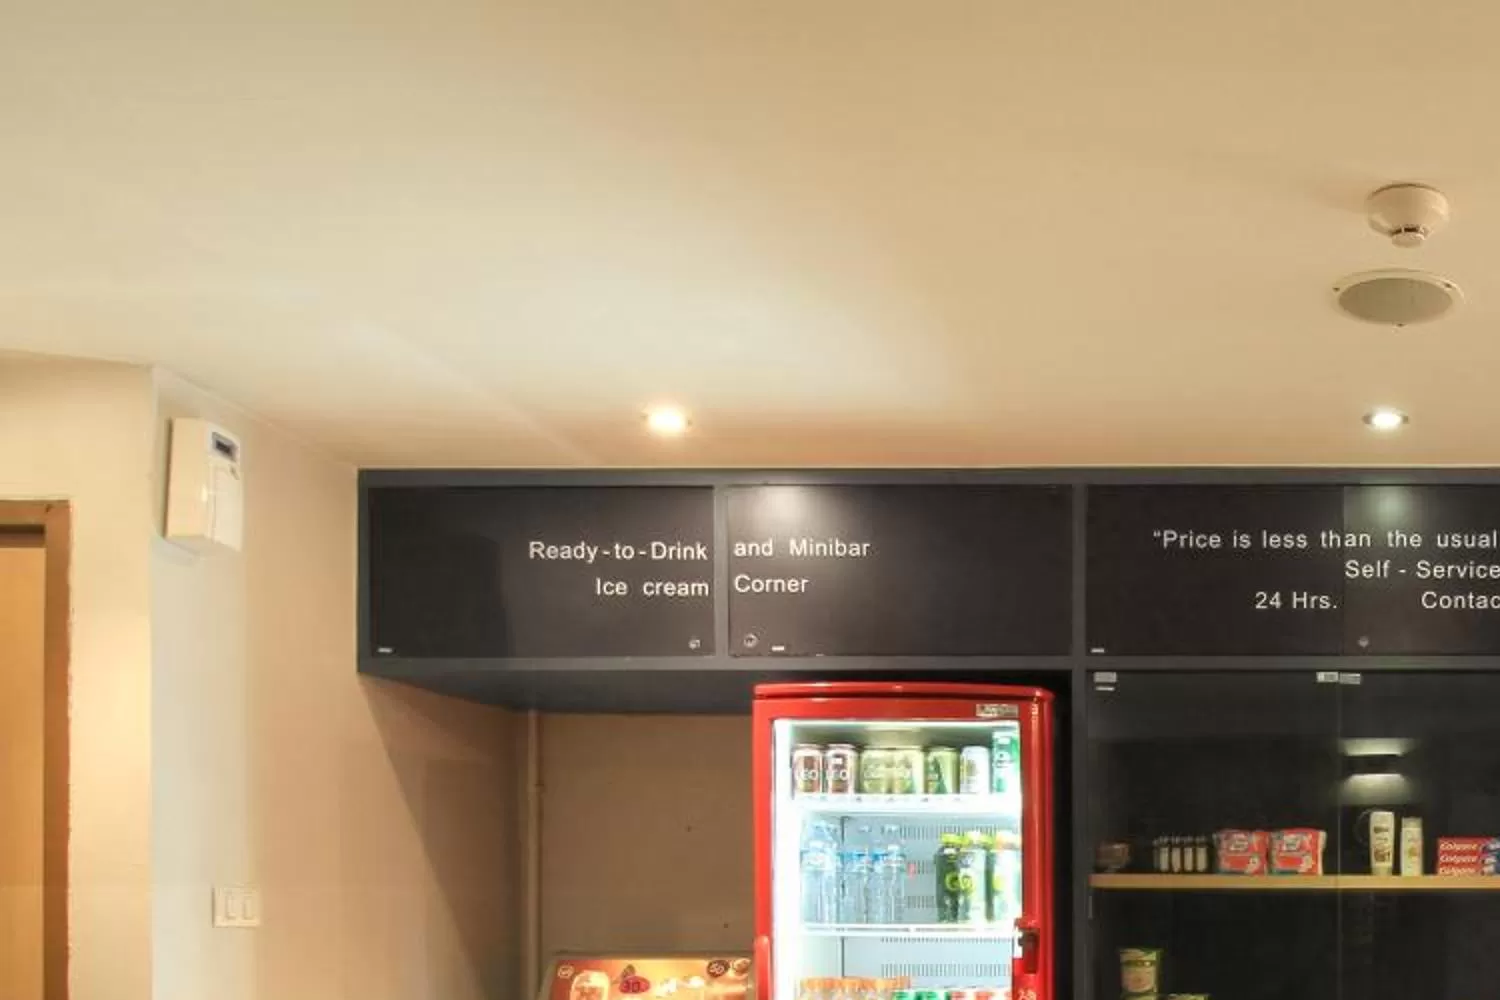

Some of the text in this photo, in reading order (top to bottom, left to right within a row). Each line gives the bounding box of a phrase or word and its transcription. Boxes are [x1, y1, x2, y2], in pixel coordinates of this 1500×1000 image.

[733, 539, 773, 557] and
[789, 538, 871, 557] Minibar
[1232, 529, 1252, 549] is
[1262, 529, 1308, 549] less
[1320, 529, 1371, 549] than
[1387, 529, 1423, 549] the
[1436, 529, 1497, 549] usual
[1344, 559, 1391, 579] Self
[595, 574, 809, 597] Ice cream Corner
[1255, 591, 1282, 610] 24
[1292, 591, 1338, 610] Hrs.
